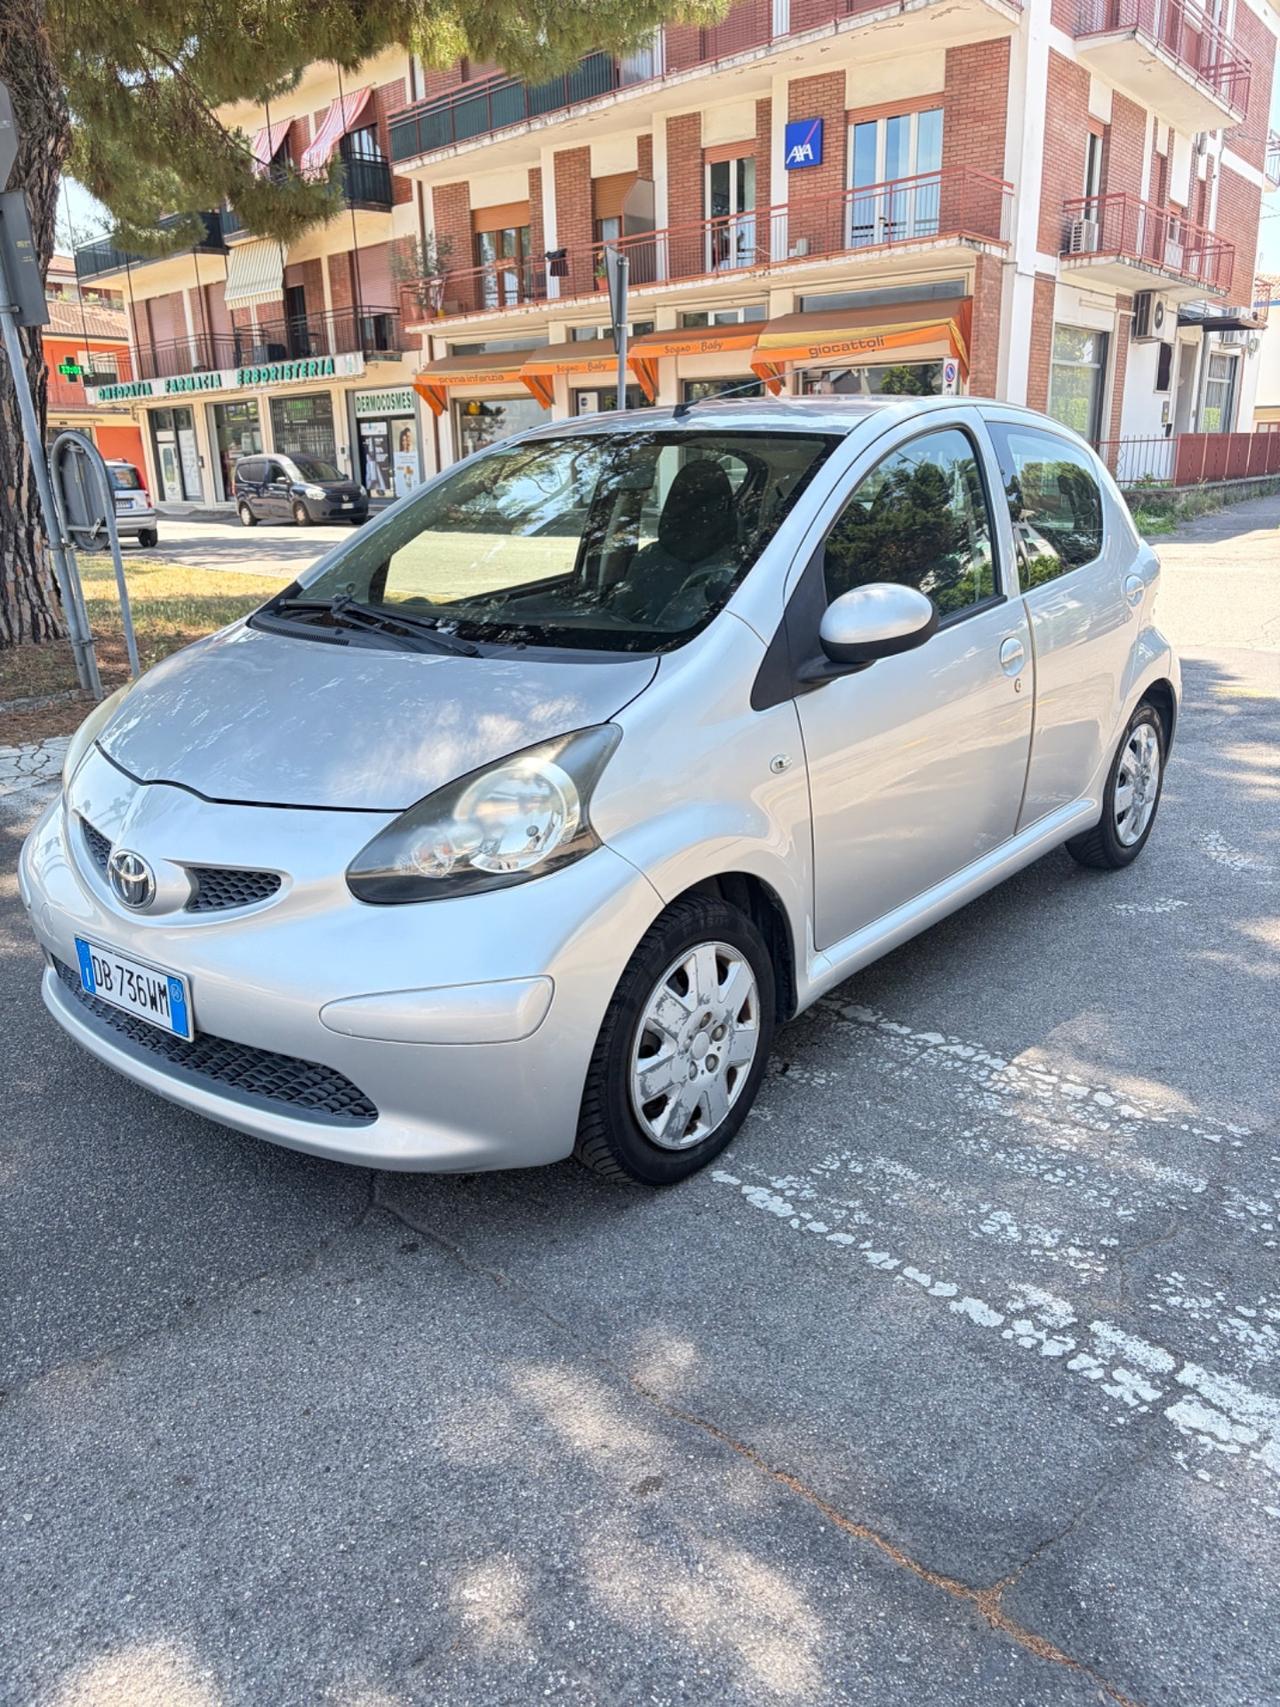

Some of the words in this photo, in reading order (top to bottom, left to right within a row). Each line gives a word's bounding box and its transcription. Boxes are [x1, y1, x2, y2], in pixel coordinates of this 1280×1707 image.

[786, 143, 814, 165] AXA
[700, 339, 723, 353] Baby
[808, 335, 885, 359] giocattoli
[164, 373, 222, 394] FARMACIA
[236, 357, 335, 385] ERBORISTERIA
[92, 955, 113, 991] DB
[115, 965, 170, 1018] 736WM
